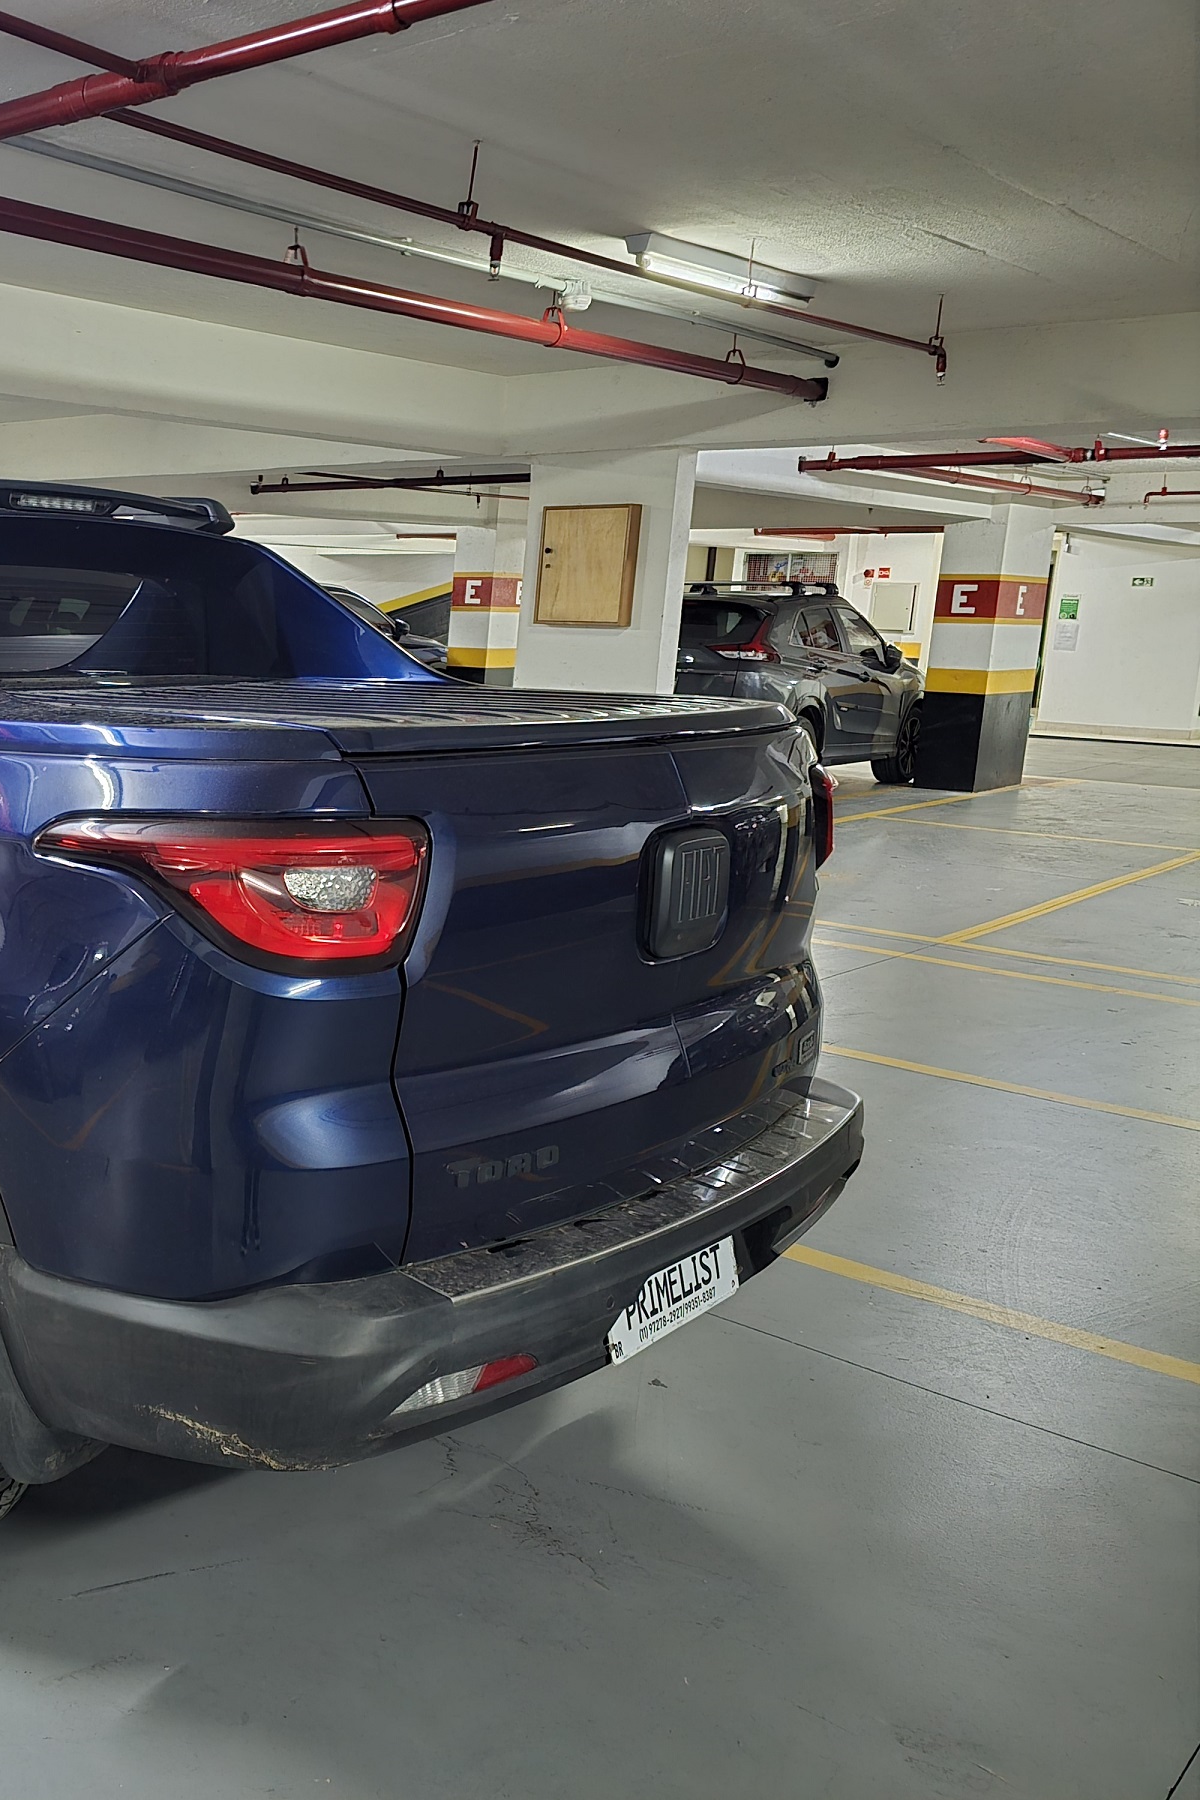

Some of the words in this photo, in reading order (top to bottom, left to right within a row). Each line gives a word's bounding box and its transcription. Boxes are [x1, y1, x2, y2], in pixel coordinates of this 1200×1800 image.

[464, 580, 482, 604] E
[950, 584, 979, 614] E
[1015, 585, 1027, 615] E
[678, 846, 726, 923] FIAT
[443, 1145, 560, 1188] TORO
[625, 1243, 721, 1331] PRIMELIST
[614, 1341, 625, 1358] BR
